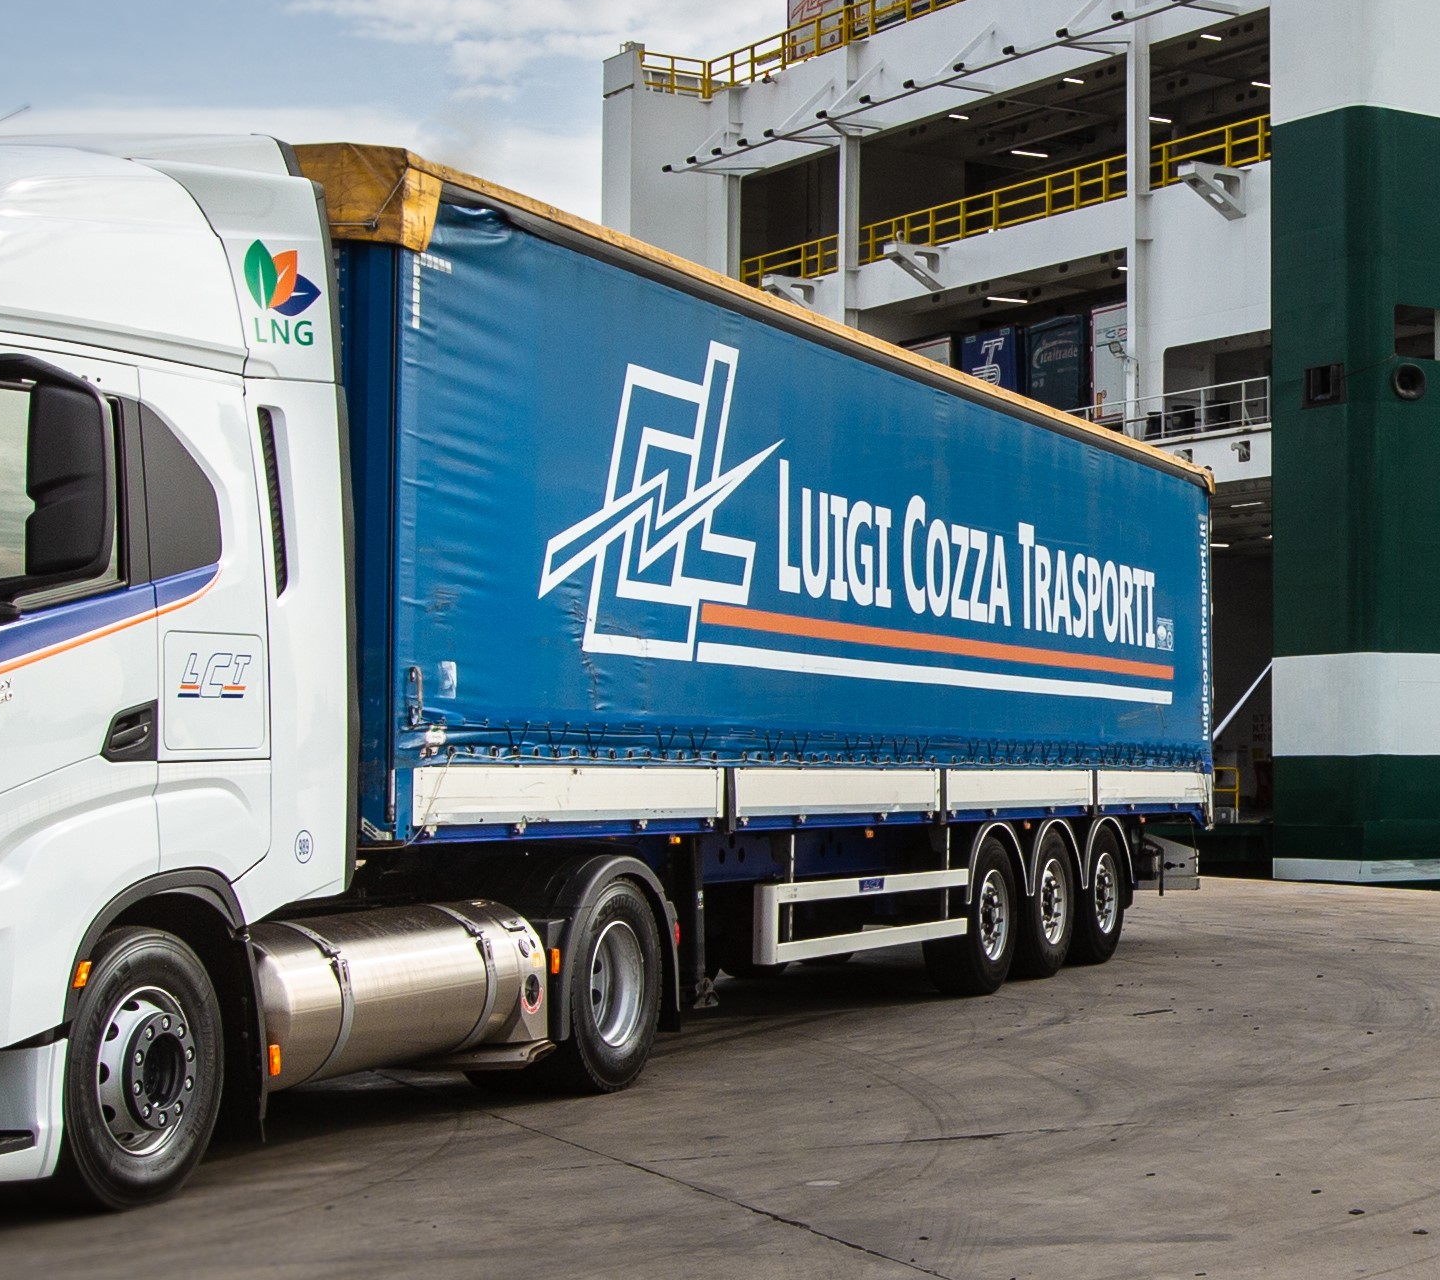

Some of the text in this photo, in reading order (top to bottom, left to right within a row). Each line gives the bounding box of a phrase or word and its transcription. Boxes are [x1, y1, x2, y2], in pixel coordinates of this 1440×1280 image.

[254, 317, 314, 346] LNG
[778, 458, 1156, 650] LUIGI COZZA TRASPORTI
[181, 652, 252, 698] LCT
